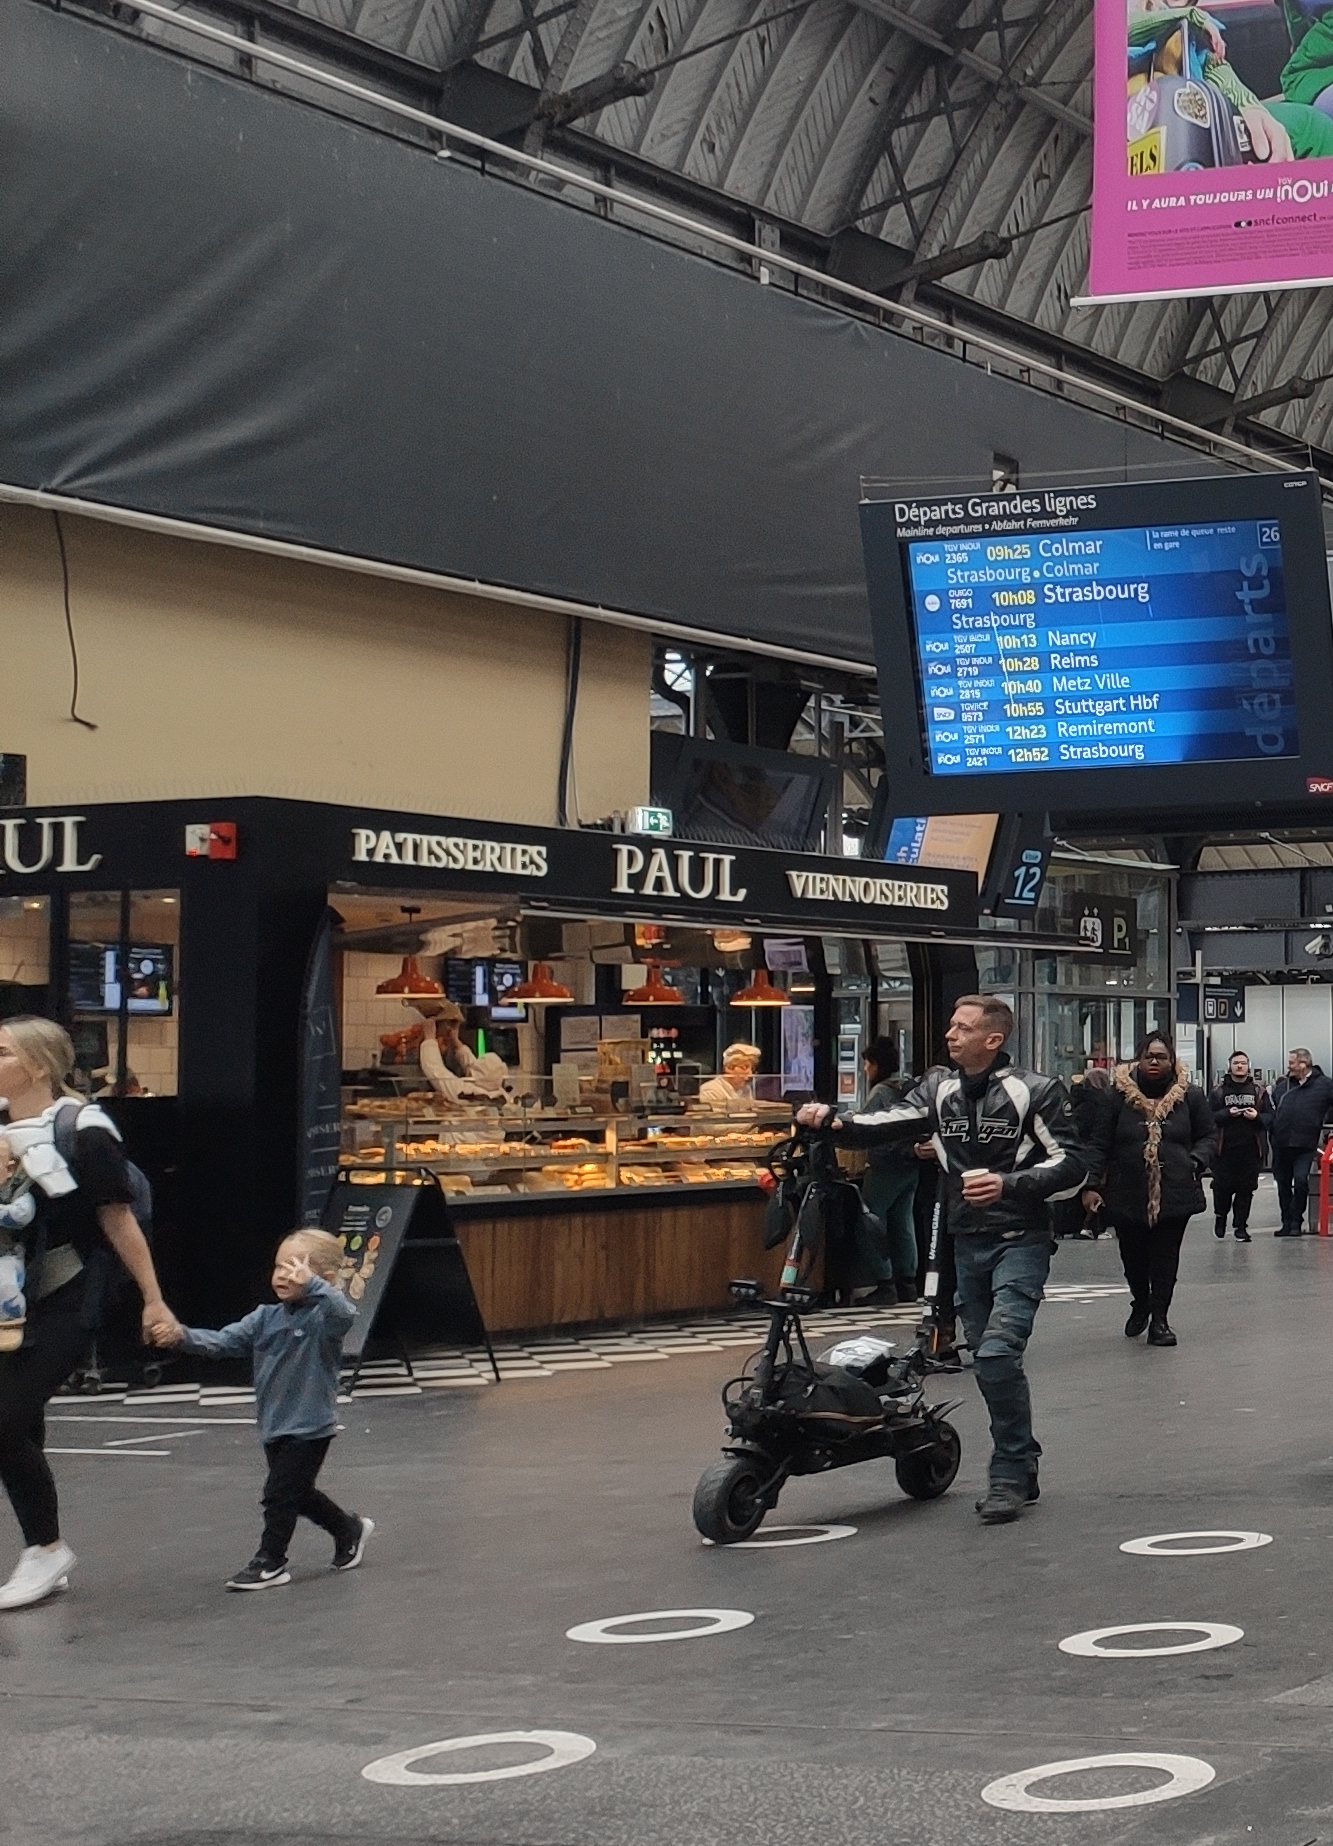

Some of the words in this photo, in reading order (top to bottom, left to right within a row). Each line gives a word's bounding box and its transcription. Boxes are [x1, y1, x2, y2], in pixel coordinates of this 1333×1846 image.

[1128, 200, 1138, 211] IL
[1142, 199, 1150, 209] Y
[1152, 196, 1186, 209] AURA
[1190, 190, 1252, 205] TOUJOURS
[1257, 188, 1273, 198] UN
[895, 502, 964, 525] Départs
[968, 495, 1041, 517] Grandes
[1044, 493, 1096, 515] lignes
[897, 527, 934, 538] Mainline
[936, 523, 982, 536] departures
[991, 520, 1024, 531] Abfahrt
[1262, 527, 1280, 542] 26
[945, 553, 968, 564] 2365
[987, 545, 1031, 560] 09h25
[1039, 538, 1102, 556] Colmar
[948, 567, 1031, 584] Strasbourg
[1043, 561, 1099, 578] Colmar
[992, 590, 1036, 606] 10h08
[1044, 581, 1149, 602] Strasbourg
[952, 612, 1035, 629] Strasbourg
[998, 634, 1037, 649] 10h13
[1048, 631, 1096, 648] Nancy
[1000, 657, 1039, 672] 10h28
[1051, 653, 1098, 669] Reims
[1001, 679, 1041, 695] 10h40
[1053, 677, 1092, 692] Metz
[1095, 673, 1130, 690] Ville
[1003, 703, 1044, 717] 10h55
[1055, 698, 1126, 715] Stuttgart
[1130, 694, 1159, 711] Hbf
[1006, 725, 1046, 740] 12h23
[1057, 719, 1155, 738] Remiremont
[1008, 748, 1049, 762] 12h52
[1060, 742, 1144, 761] Strasbourg
[1308, 782, 1333, 793] SNCF
[0, 815, 103, 875] UL
[351, 828, 548, 877] PATISSERIES
[611, 843, 747, 902] PAUL
[786, 870, 949, 911] VIENNOISERIES
[1014, 866, 1041, 899] 12
